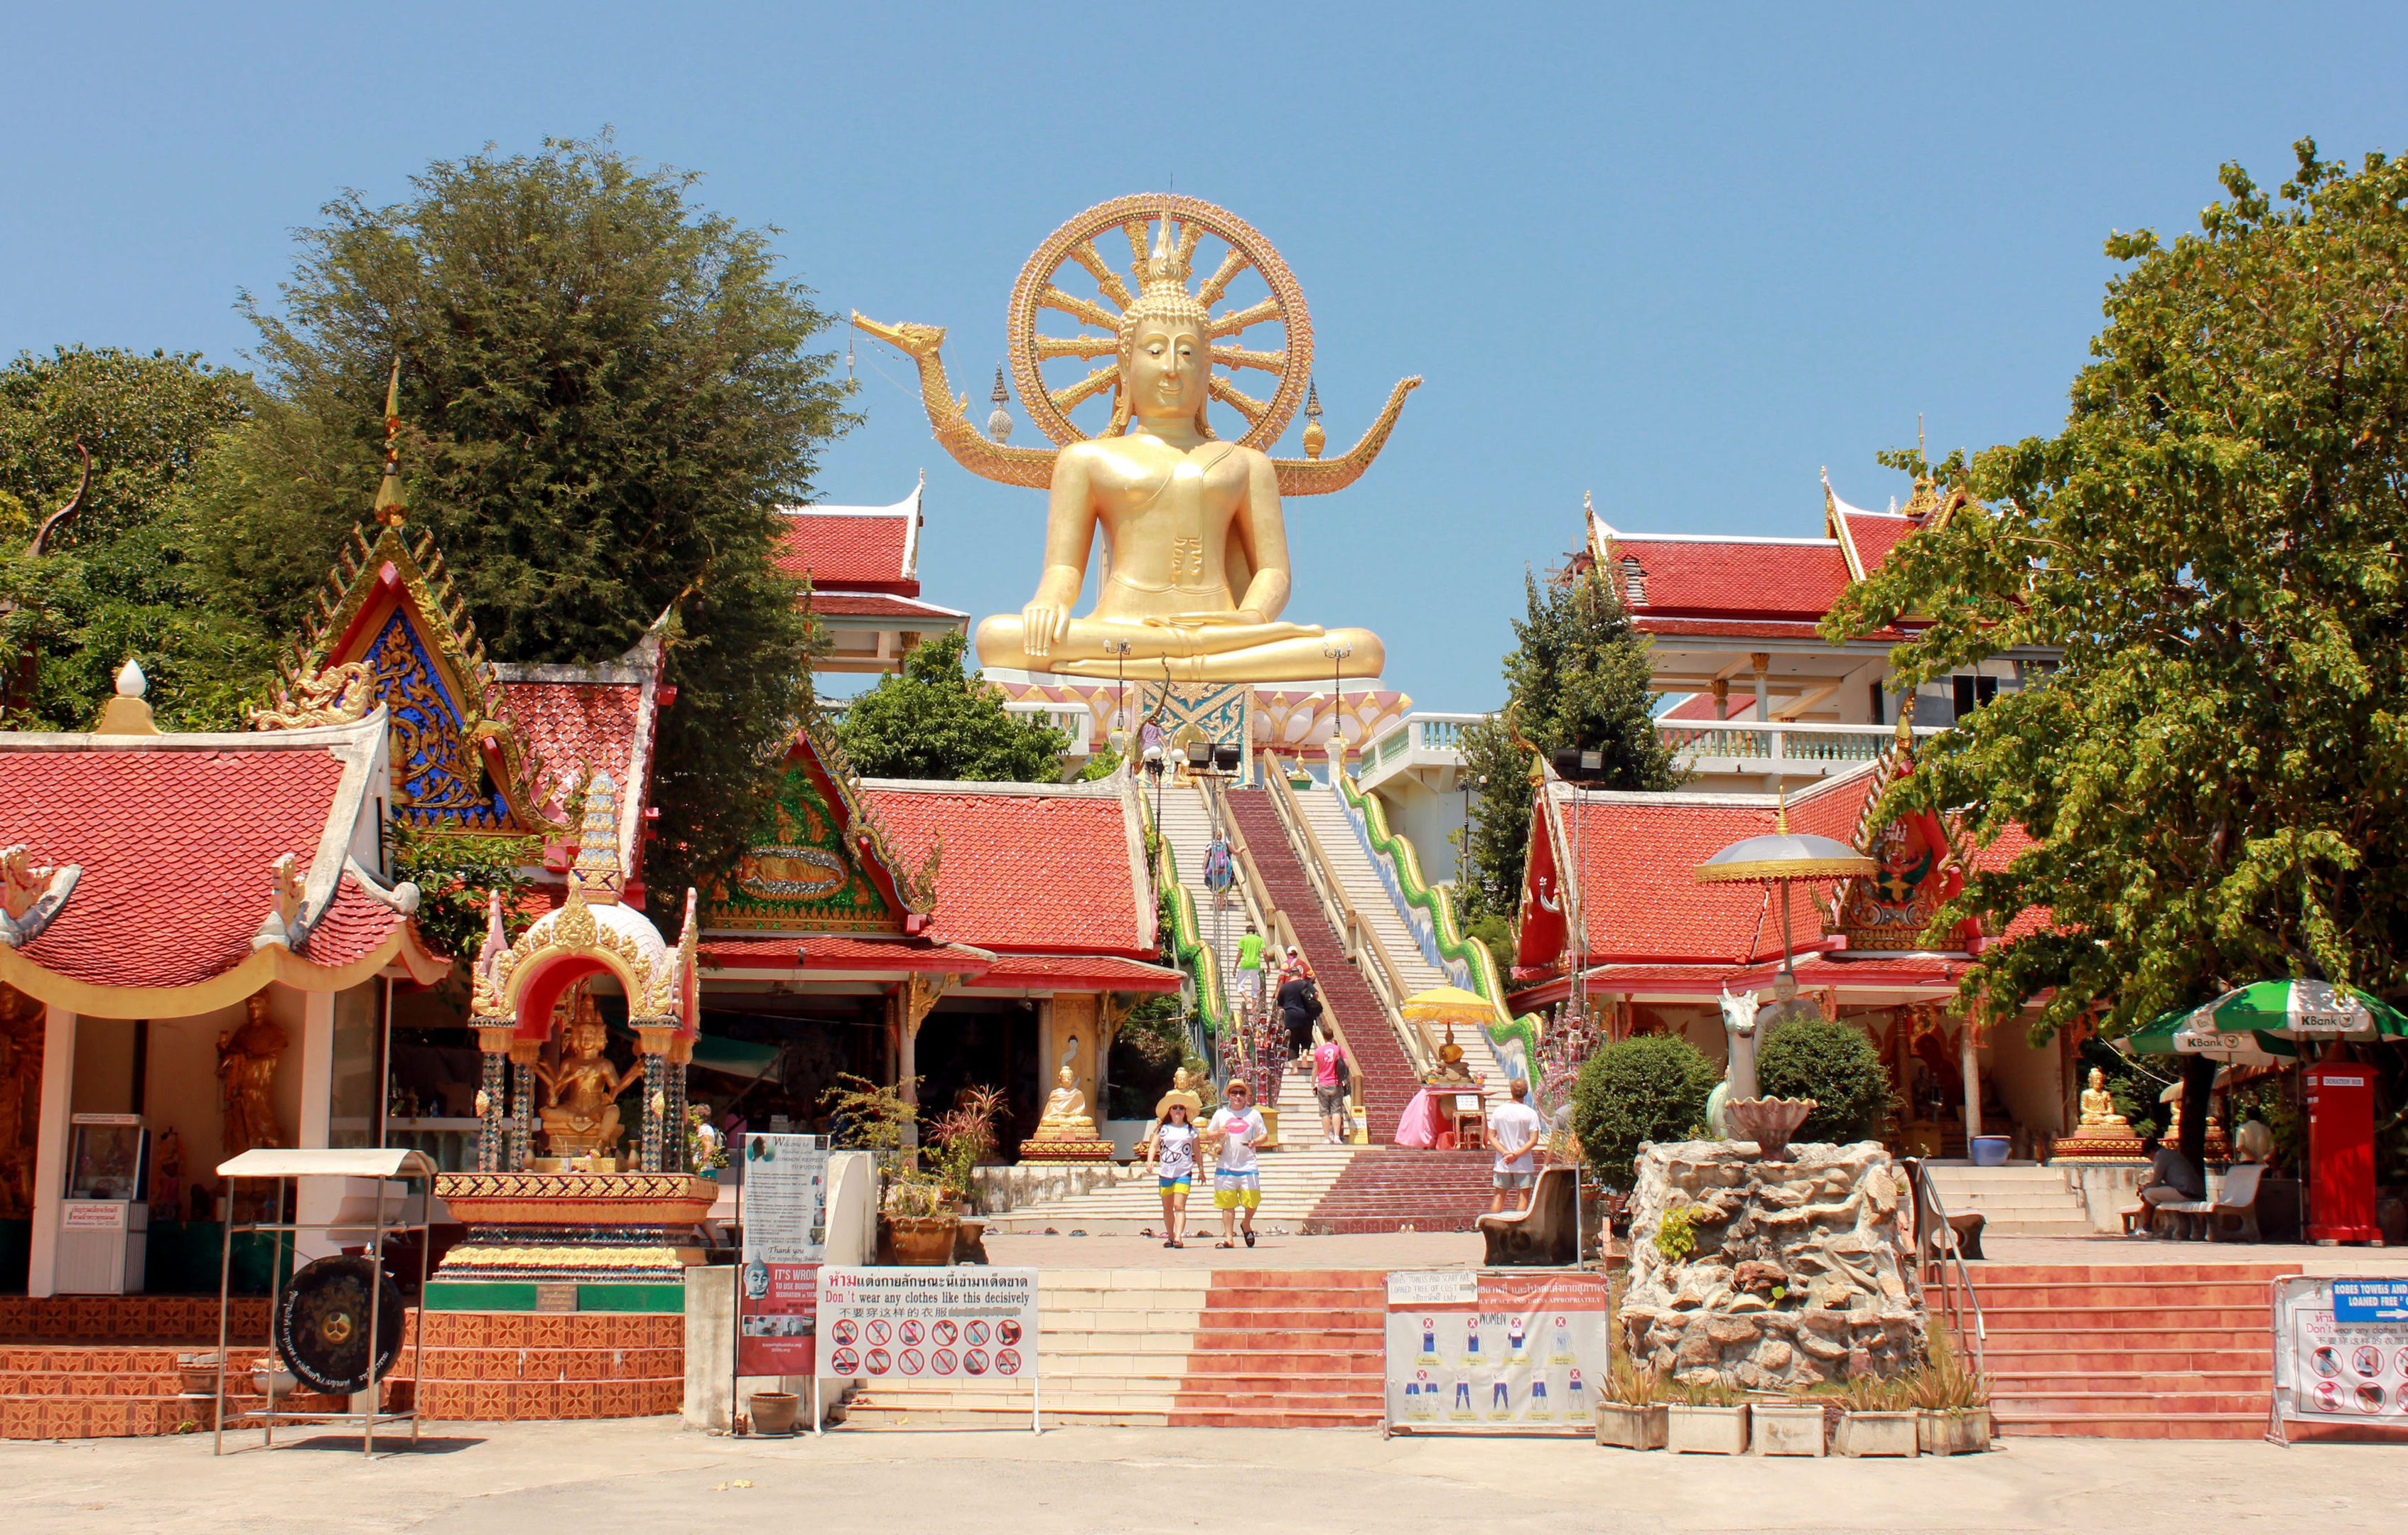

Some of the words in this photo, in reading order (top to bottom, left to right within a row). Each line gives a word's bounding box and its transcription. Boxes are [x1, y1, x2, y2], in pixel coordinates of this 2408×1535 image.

[2301, 1016, 2337, 1026] KBank
[2188, 1037, 2223, 1047] KBank
[1324, 1048, 1335, 1062] 3
[774, 1269, 791, 1281] IT'S
[793, 1269, 816, 1281] WRON
[828, 1270, 1028, 1287] ห้ามแต่งกายลักษณะนี้เข้ามาเด็ดขาด
[1440, 1283, 1457, 1292] COST
[2334, 1284, 2359, 1294] ROBES
[2391, 1283, 2408, 1294] AND
[859, 1294, 881, 1303] wear
[885, 1294, 901, 1306] any
[905, 1291, 938, 1303] clothes
[942, 1292, 959, 1303] like
[963, 1292, 981, 1303] this
[985, 1292, 1030, 1306] decisively
[2348, 1296, 2379, 1306] LOANED
[2380, 1296, 2399, 1306] FREE
[838, 1308, 948, 1318] 不要穿这样的衣服
[1479, 1313, 1506, 1326] WOMEN
[2306, 1323, 2331, 1333] Don't
[2355, 1327, 2368, 1335] any
[2372, 1325, 2397, 1334] clothes
